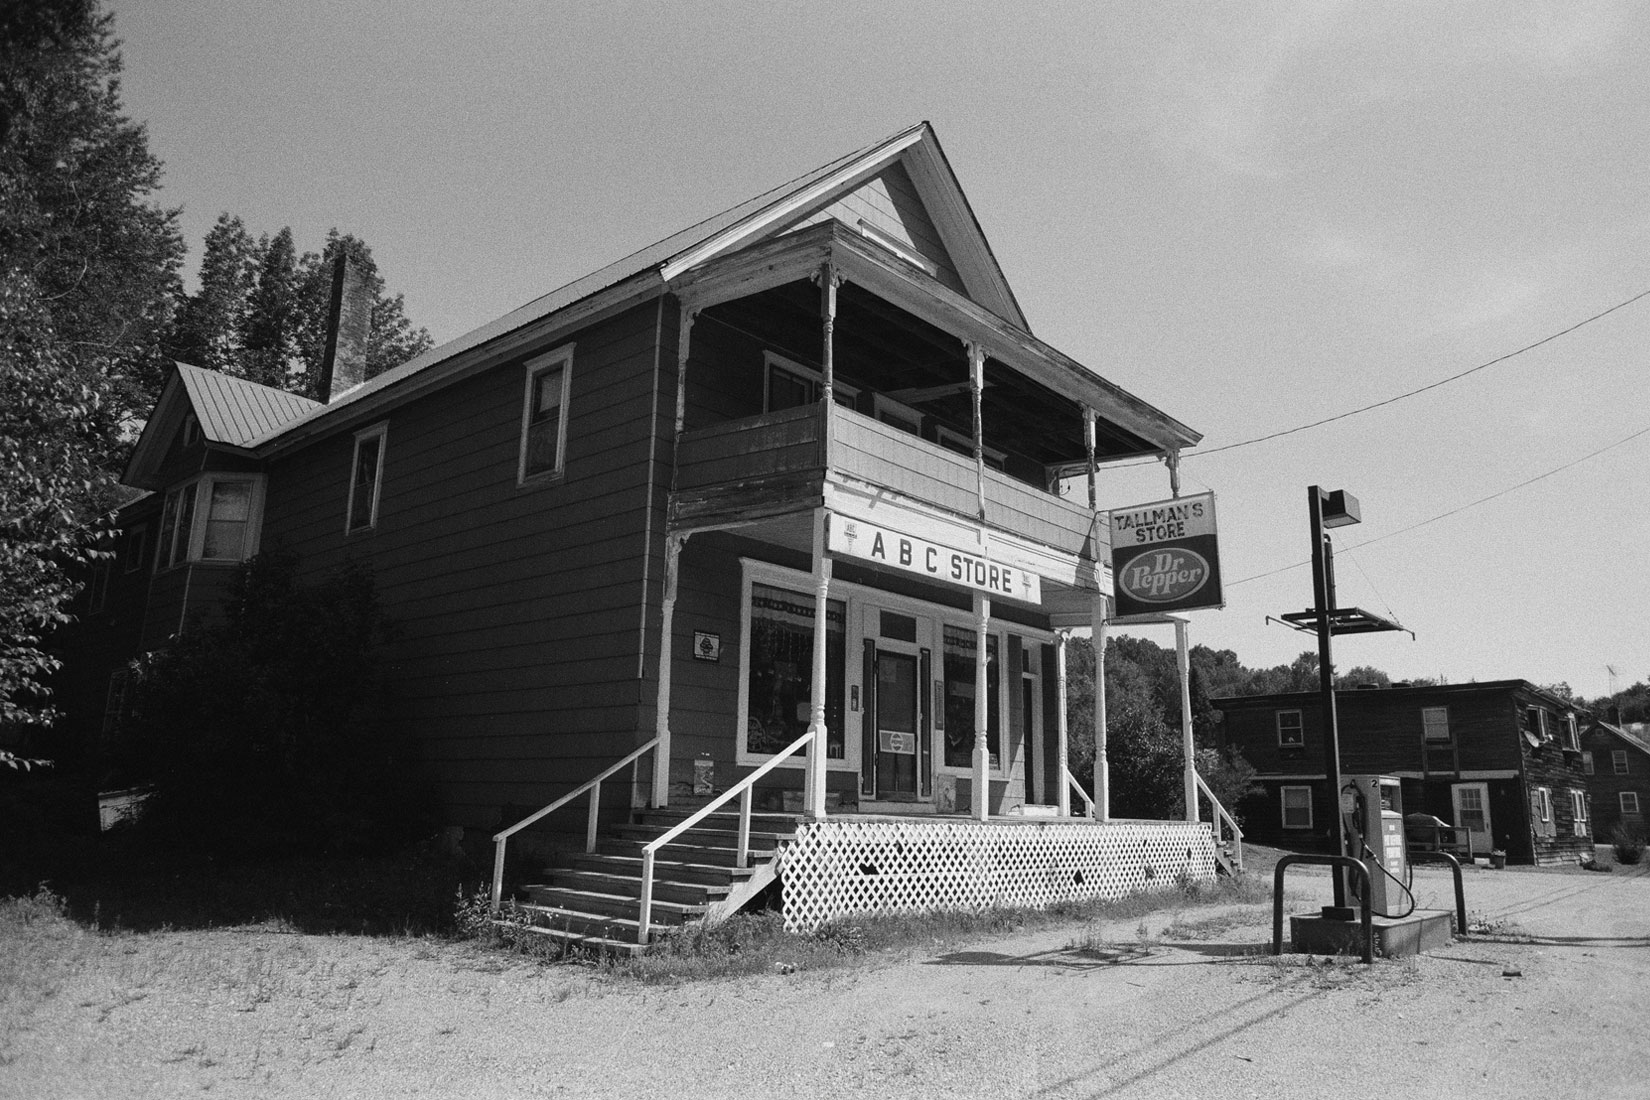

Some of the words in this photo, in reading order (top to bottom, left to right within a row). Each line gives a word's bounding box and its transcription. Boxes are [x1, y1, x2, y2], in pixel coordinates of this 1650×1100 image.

[1114, 502, 1204, 531] TALLMAN'S
[1135, 521, 1185, 543] STORE
[951, 554, 1012, 593] STORE
[1153, 553, 1185, 573] Dr
[1130, 565, 1202, 596] Pepper
[1371, 779, 1378, 788] 2
